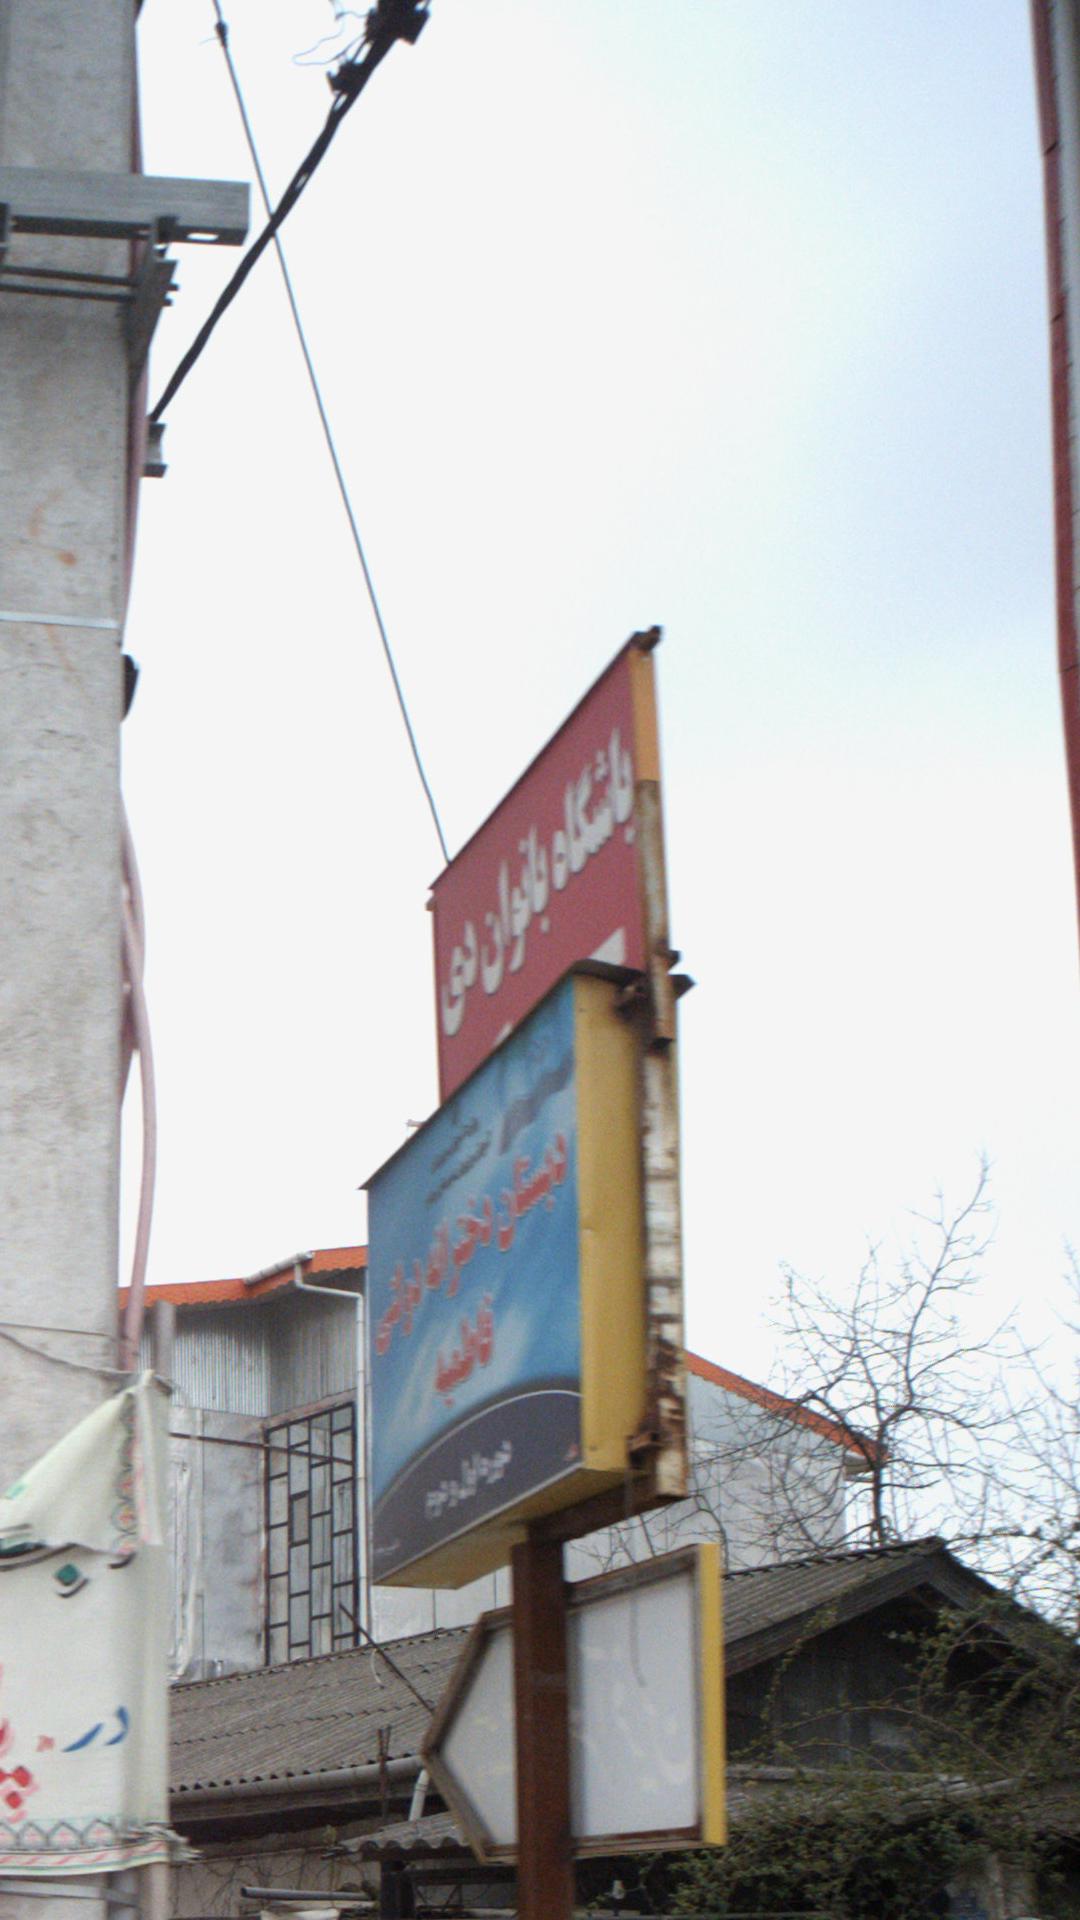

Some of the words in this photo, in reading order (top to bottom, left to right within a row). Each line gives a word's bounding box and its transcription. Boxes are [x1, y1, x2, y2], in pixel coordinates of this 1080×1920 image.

[552, 728, 635, 888] باشگاه
[481, 824, 550, 994] بانوان
[426, 1194, 494, 1297] دخترانه
[497, 1130, 569, 1253] دبستان
